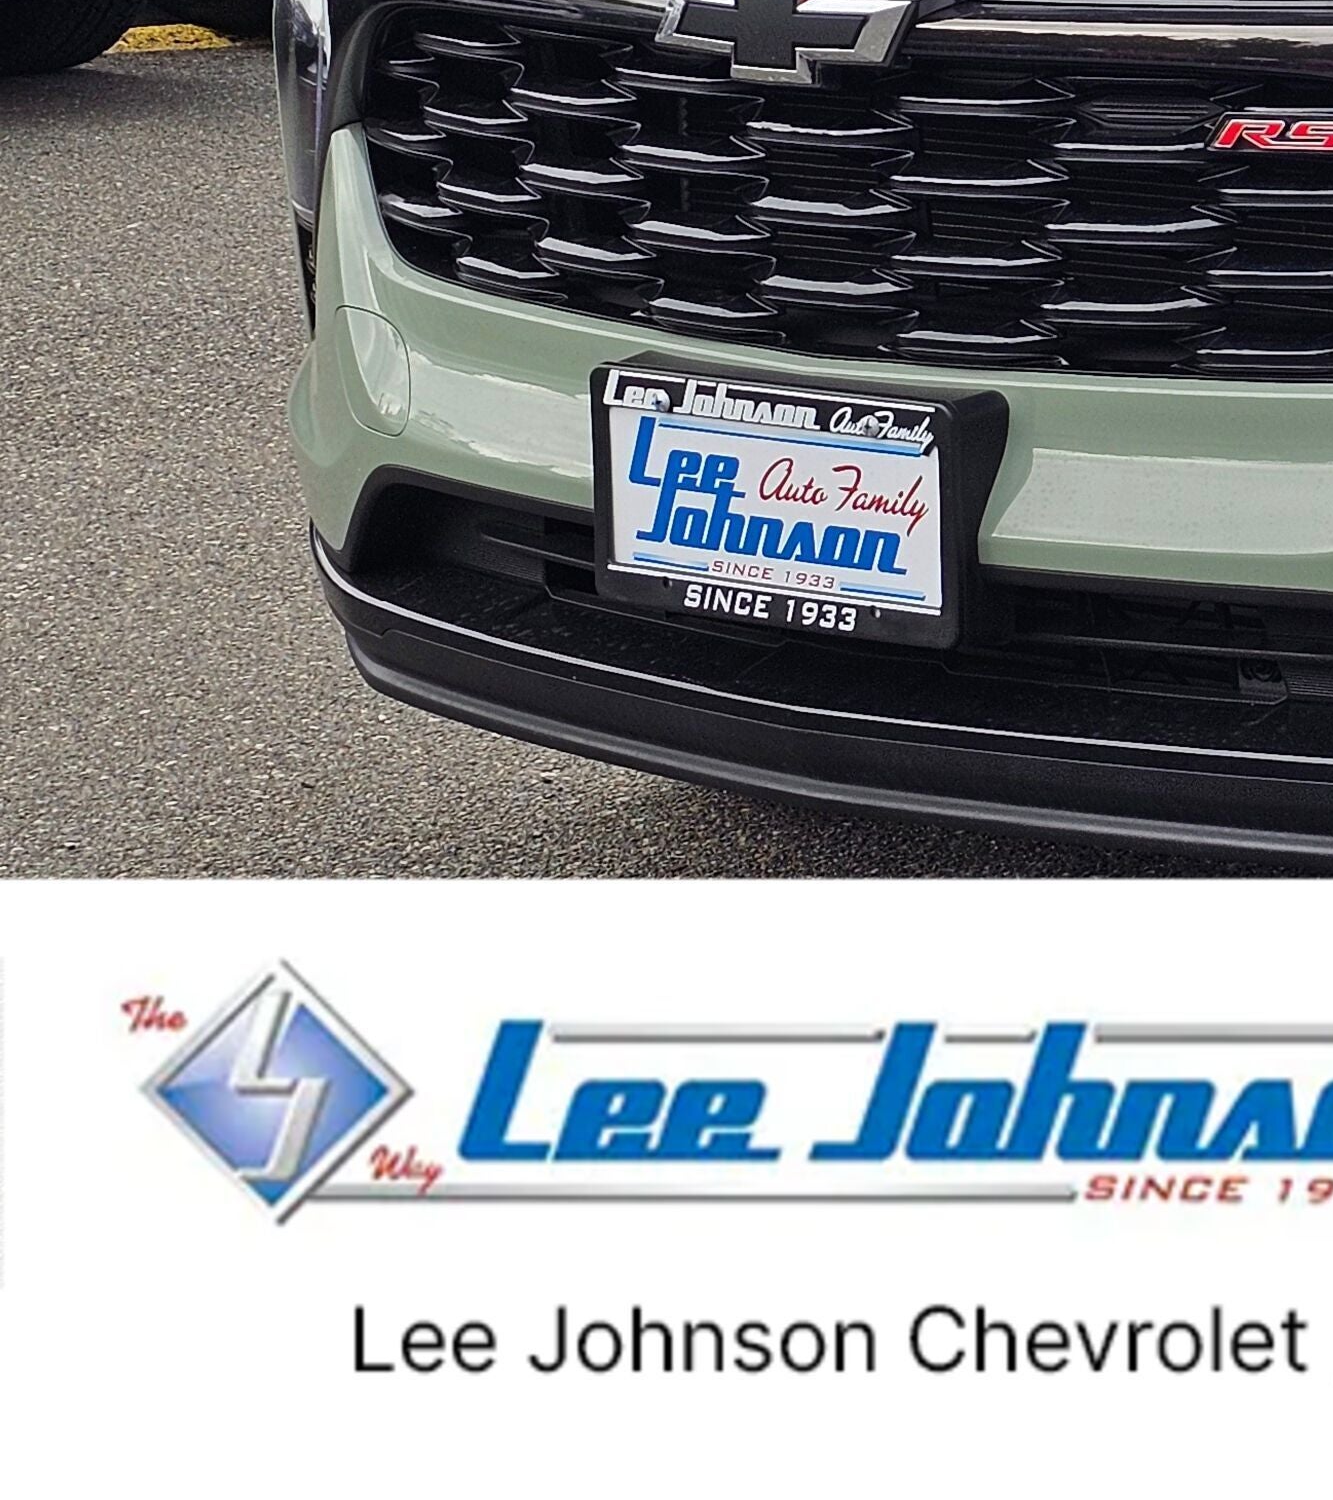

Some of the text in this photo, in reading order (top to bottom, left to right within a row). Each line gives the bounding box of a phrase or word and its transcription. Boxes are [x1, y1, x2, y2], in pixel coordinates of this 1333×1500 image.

[673, 379, 820, 430] Johnson
[874, 410, 934, 454] Family
[629, 416, 746, 498] Lee
[636, 487, 907, 575] Johnson
[758, 457, 929, 537] Auto Family
[683, 584, 857, 632] SINCE 1933
[711, 560, 836, 589] SINCE 1933
